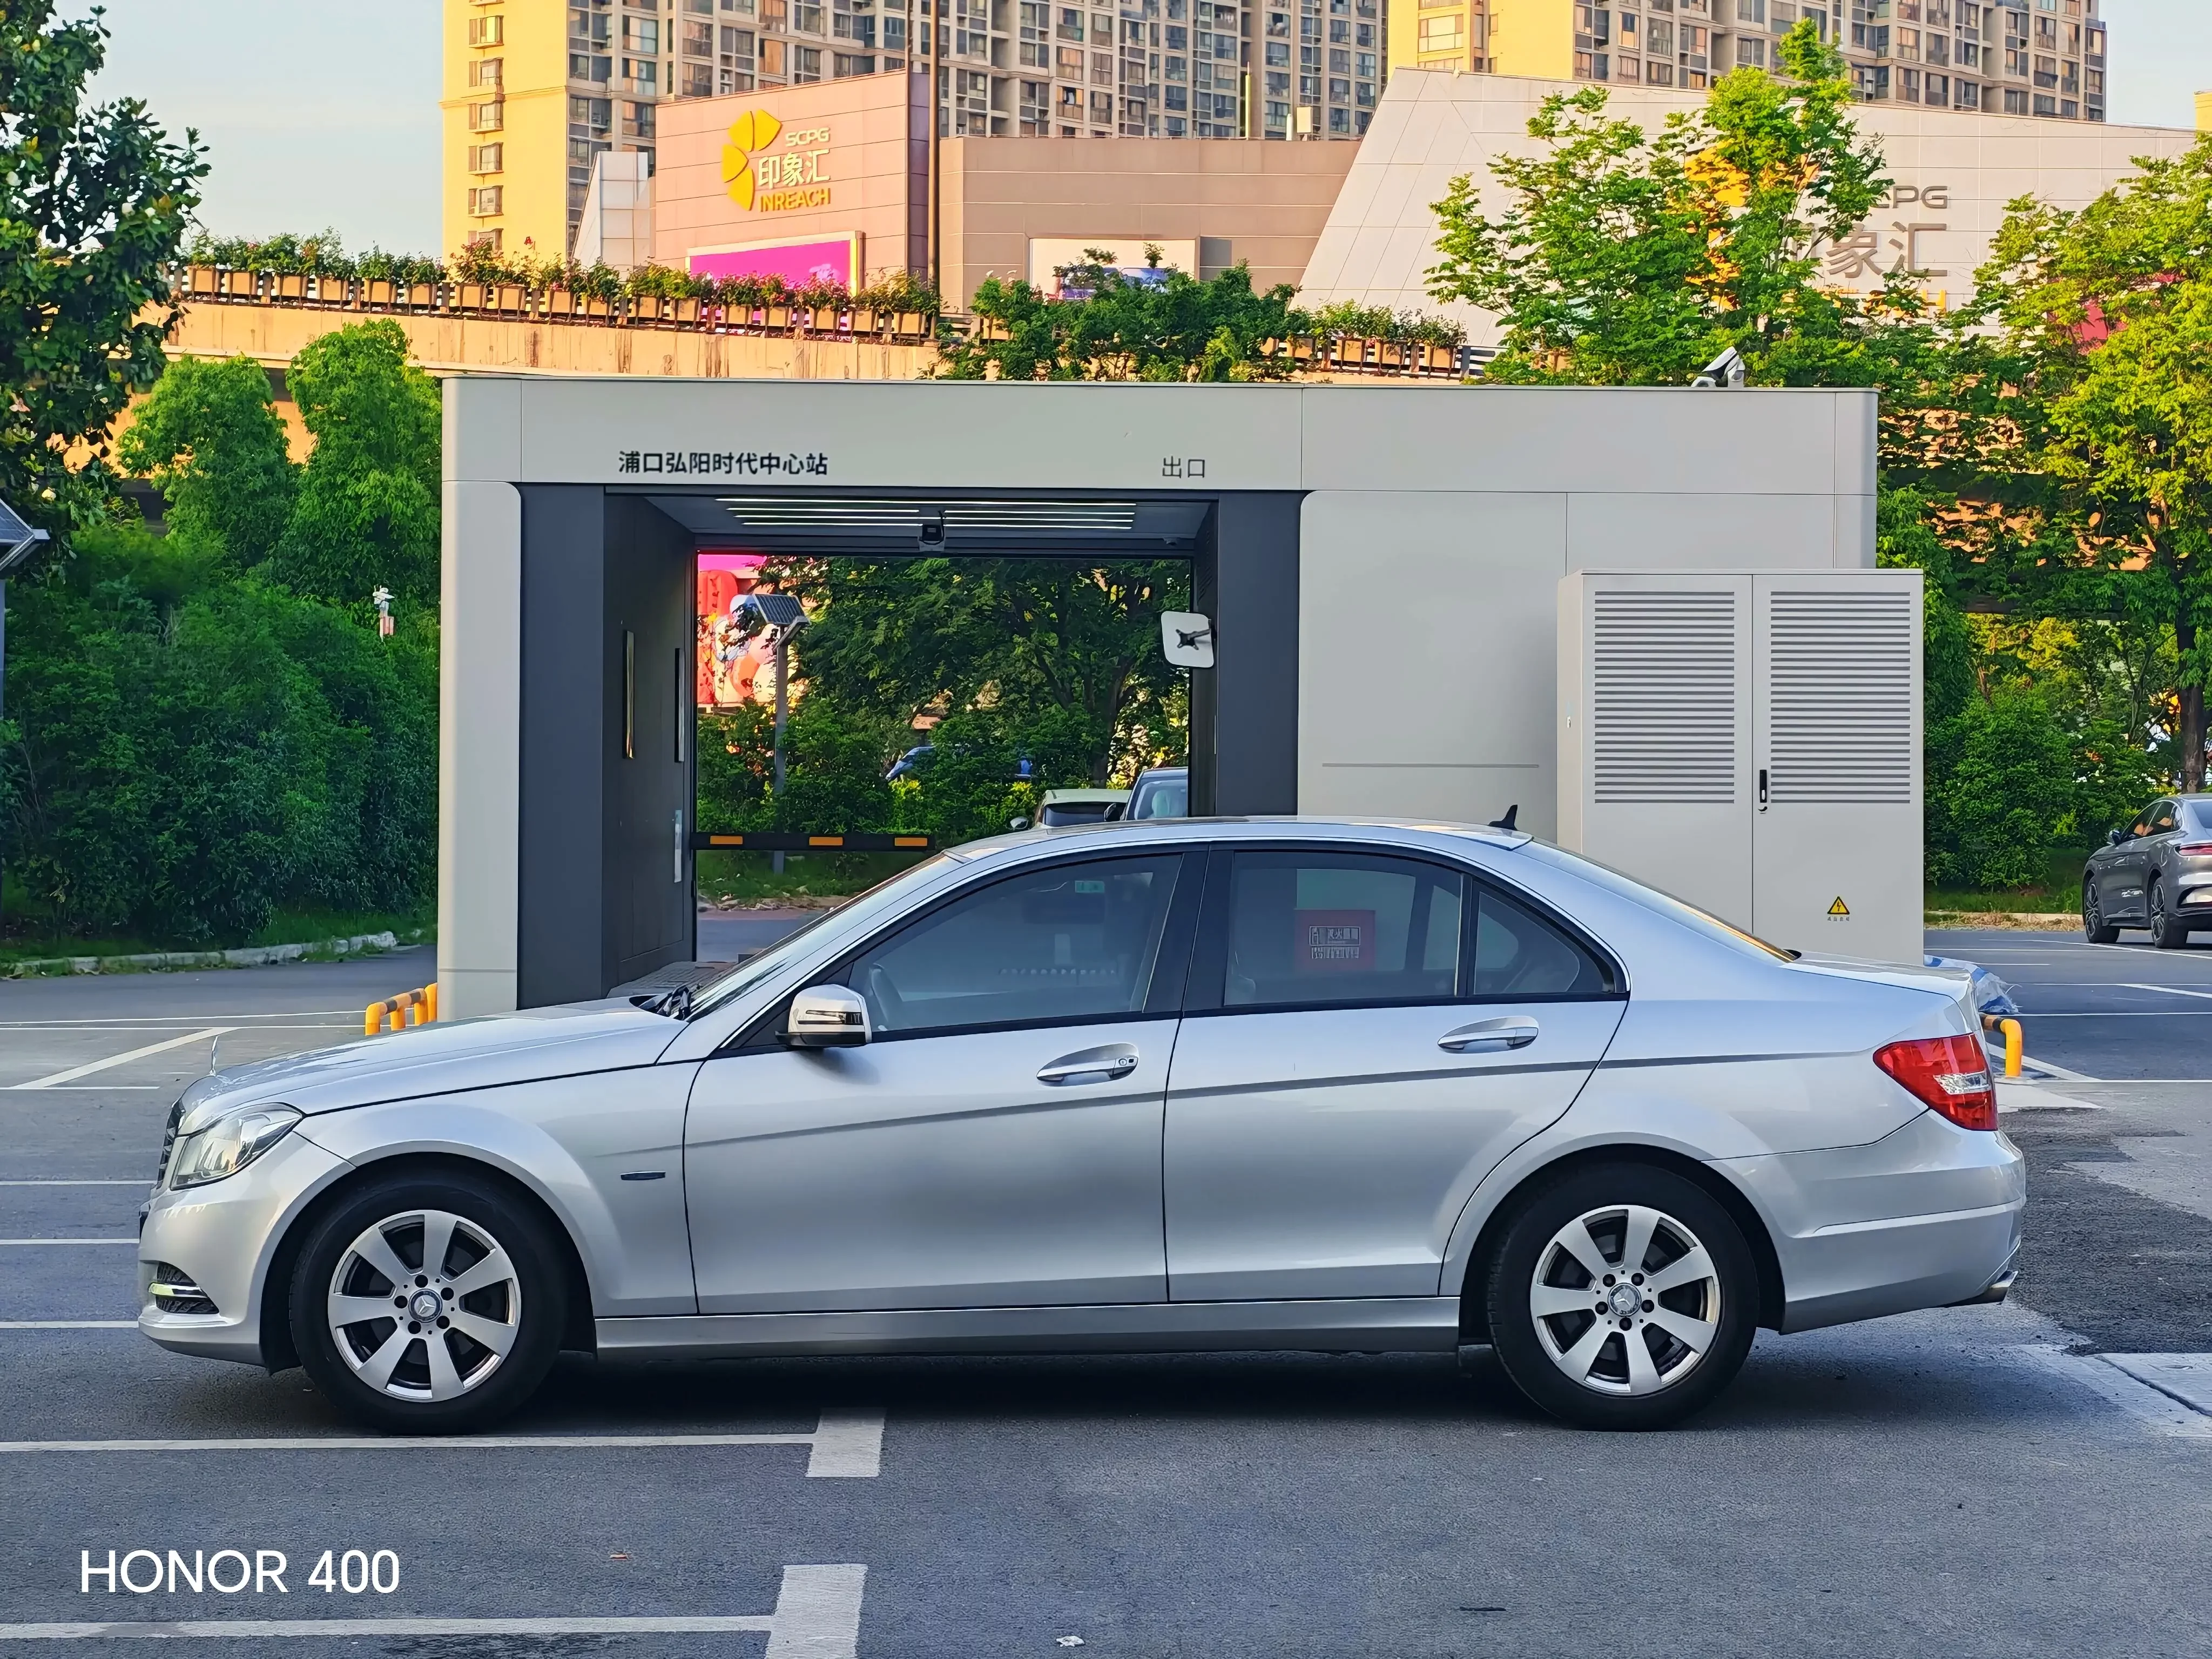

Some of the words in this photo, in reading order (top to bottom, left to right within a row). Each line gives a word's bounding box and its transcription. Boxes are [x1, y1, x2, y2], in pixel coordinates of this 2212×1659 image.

[786, 127, 830, 146] SCPG
[758, 149, 831, 189] 印象汇
[759, 188, 831, 212] INREACH
[618, 450, 828, 476] 浦口弘阳时代中心站
[1162, 456, 1205, 478] 出口
